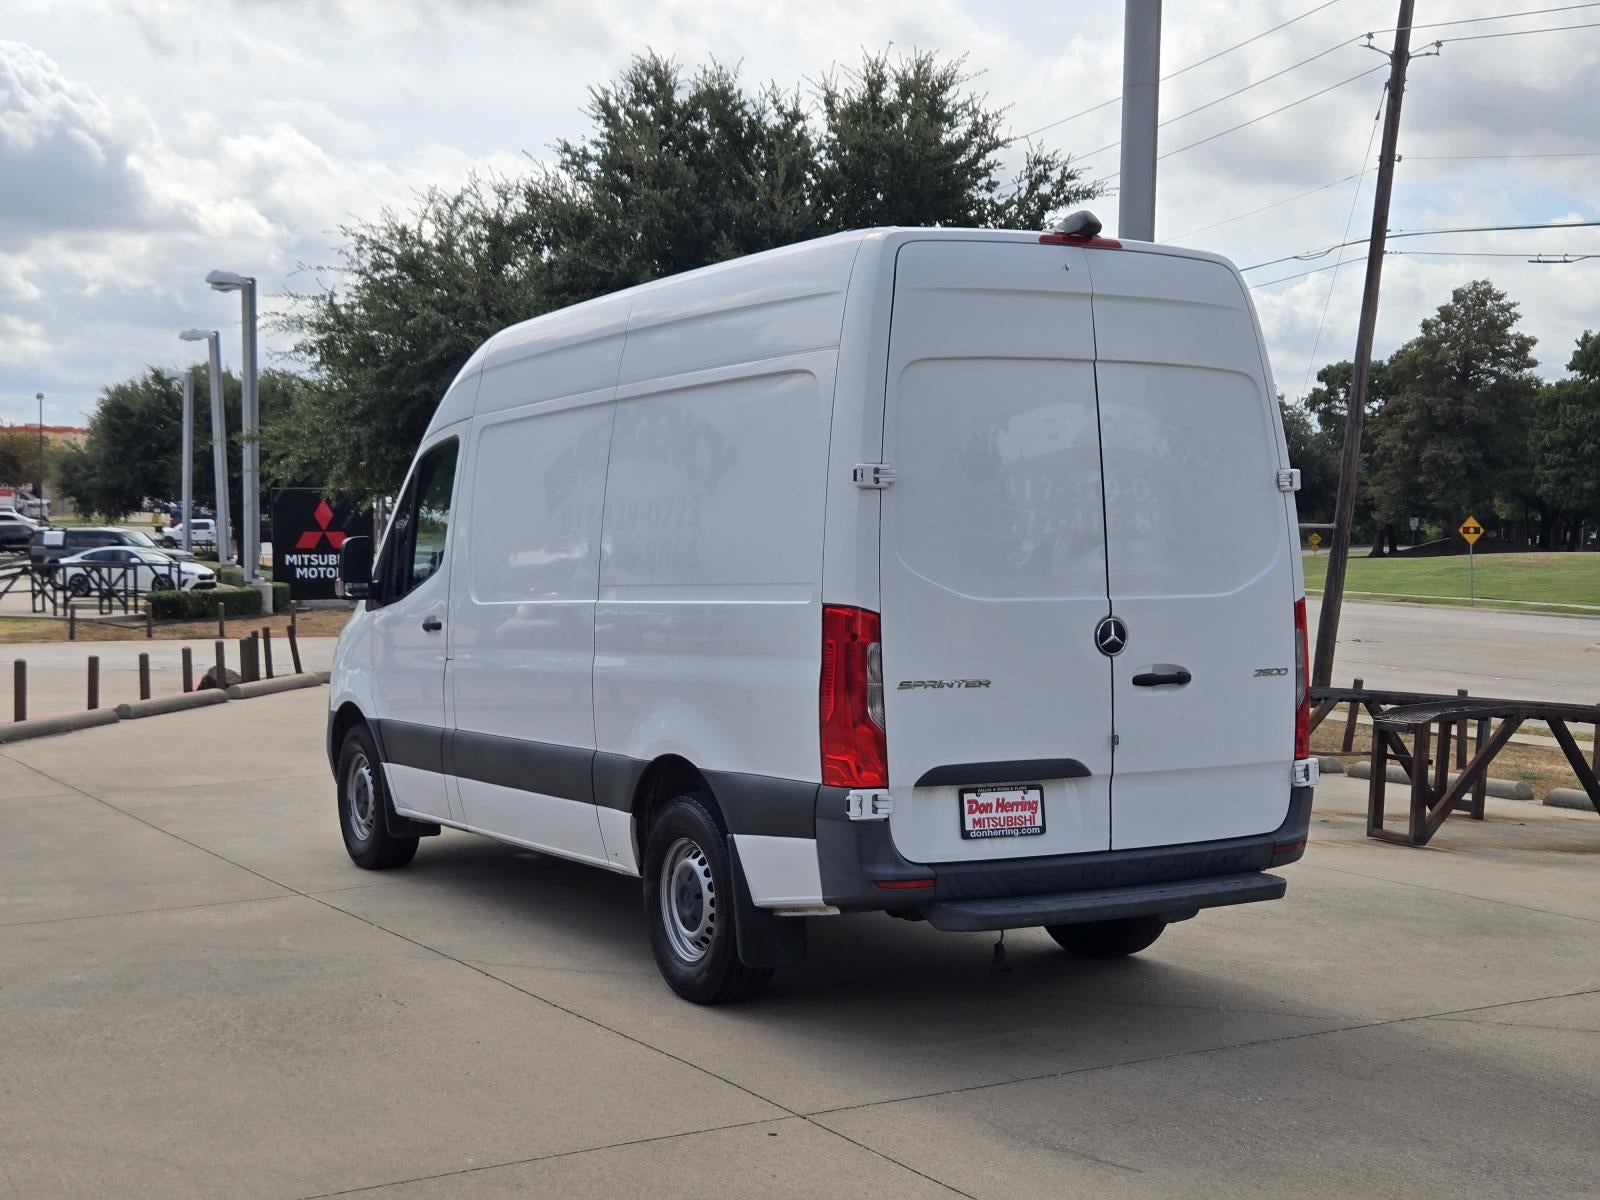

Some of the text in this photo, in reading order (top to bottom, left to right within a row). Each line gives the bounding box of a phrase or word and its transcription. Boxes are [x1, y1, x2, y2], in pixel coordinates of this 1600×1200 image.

[285, 554, 340, 566] MITSUBI
[296, 567, 339, 579] MOTO
[897, 679, 992, 690] SPRINTER
[967, 796, 1039, 815] Don Herring
[972, 815, 1036, 828] MITSUBISHI
[970, 827, 1040, 838] donherring.com
